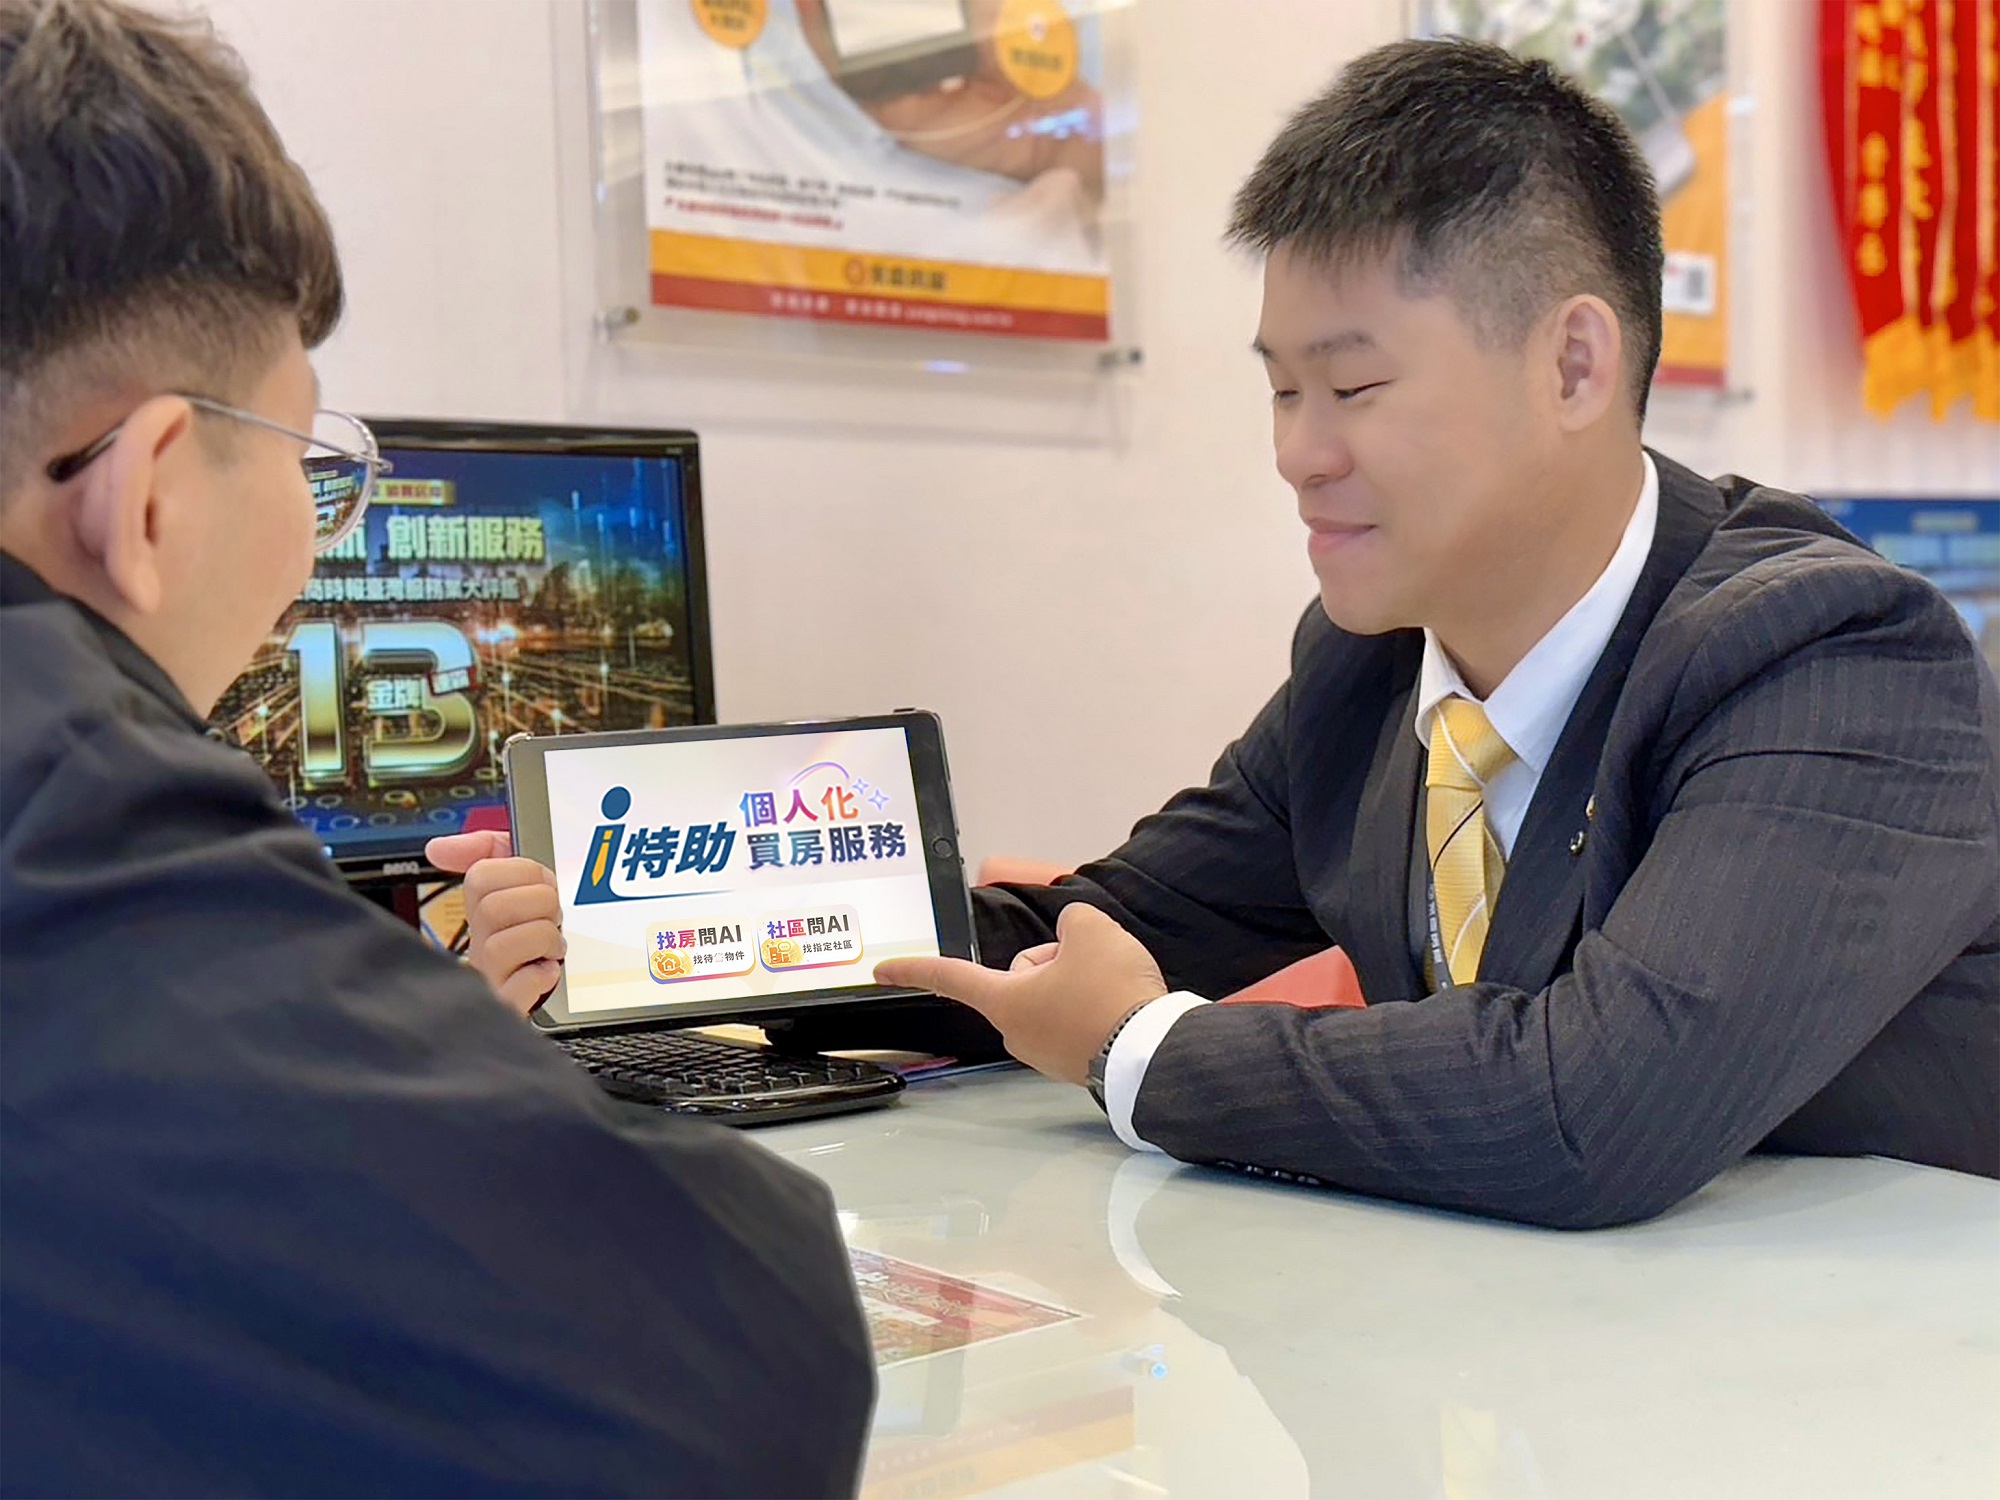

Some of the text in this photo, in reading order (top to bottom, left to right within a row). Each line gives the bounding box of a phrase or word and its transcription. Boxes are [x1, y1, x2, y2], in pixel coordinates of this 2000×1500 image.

[388, 514, 543, 559] 創新服務
[740, 786, 859, 828] 個人化
[747, 822, 907, 871] 買房服務
[657, 925, 742, 950] 找房問AI
[767, 914, 850, 939] 社區問AI
[802, 940, 853, 954] 找指定社區
